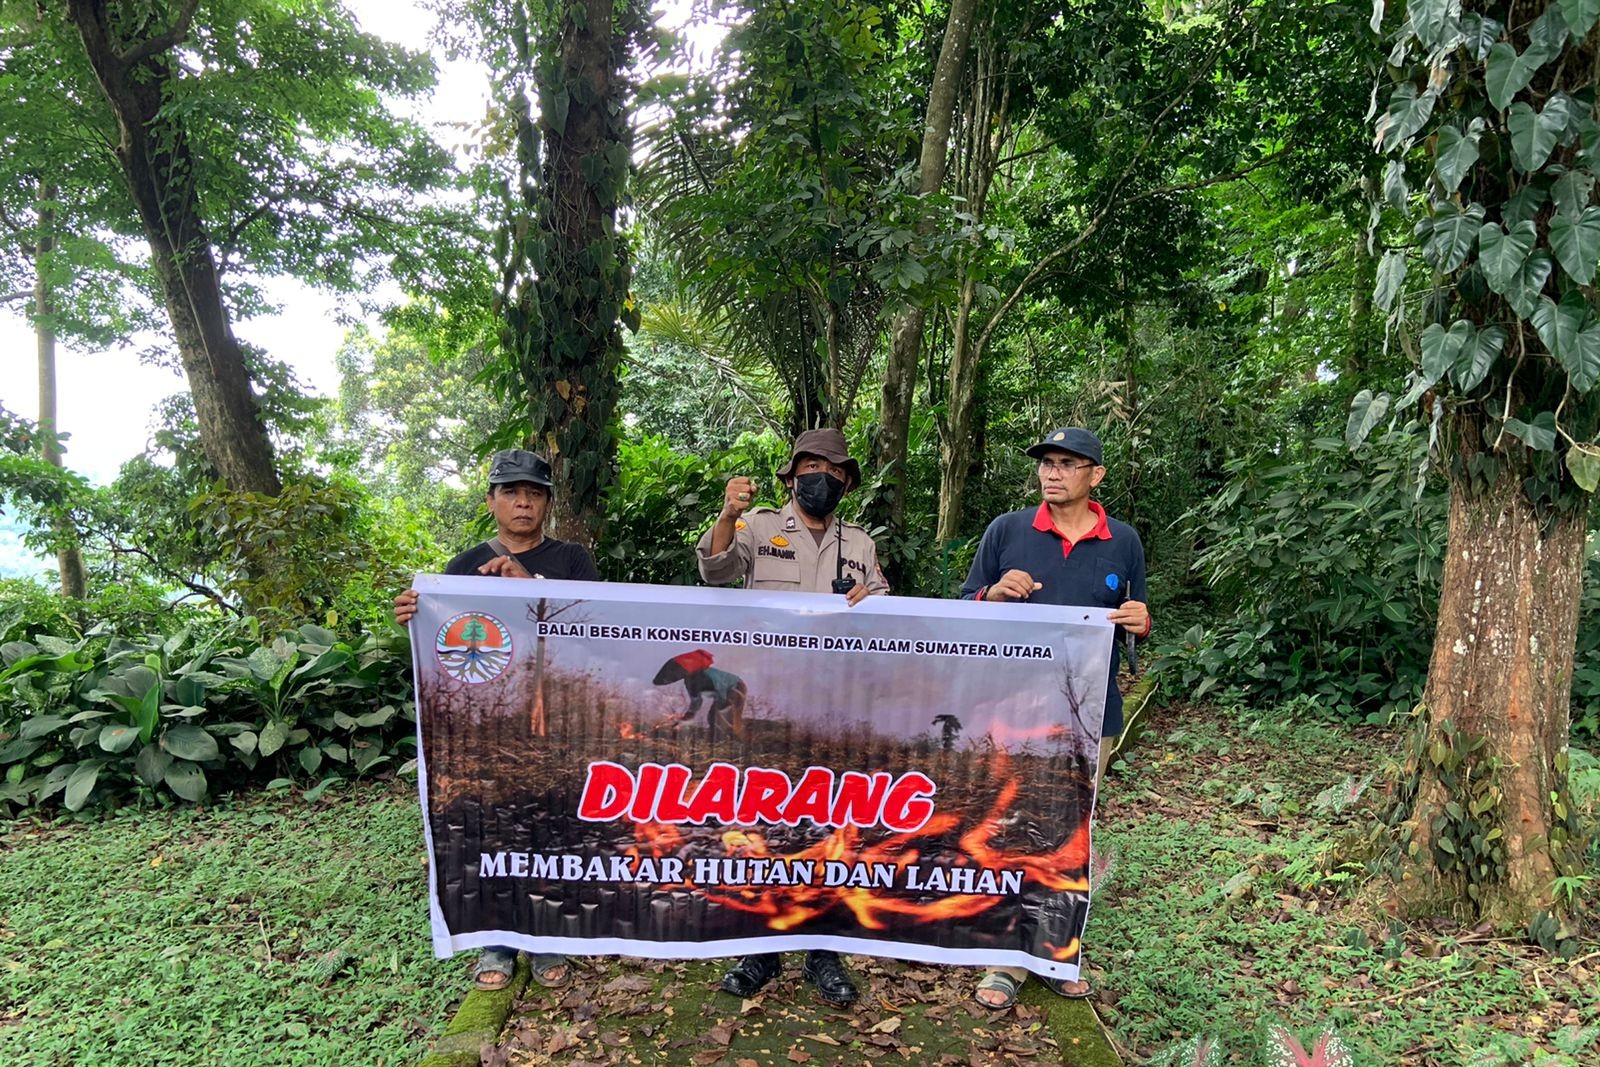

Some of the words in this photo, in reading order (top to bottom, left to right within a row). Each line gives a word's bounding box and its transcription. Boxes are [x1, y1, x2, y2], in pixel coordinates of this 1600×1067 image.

[537, 623, 585, 637] BALAI
[589, 626, 642, 640] BESAR
[646, 628, 748, 645] KONSERVASI
[752, 633, 819, 649] SUMBER
[823, 637, 863, 651] DAYA
[867, 639, 911, 653] ALAM
[914, 641, 998, 657] SUMATERA
[1002, 645, 1053, 659] UTARA
[577, 760, 937, 833] DILARANG
[478, 851, 684, 884] MEMBAKAR
[693, 857, 815, 885] HUTAN
[823, 860, 897, 888] DAN
[905, 865, 1025, 895] LAHAN
